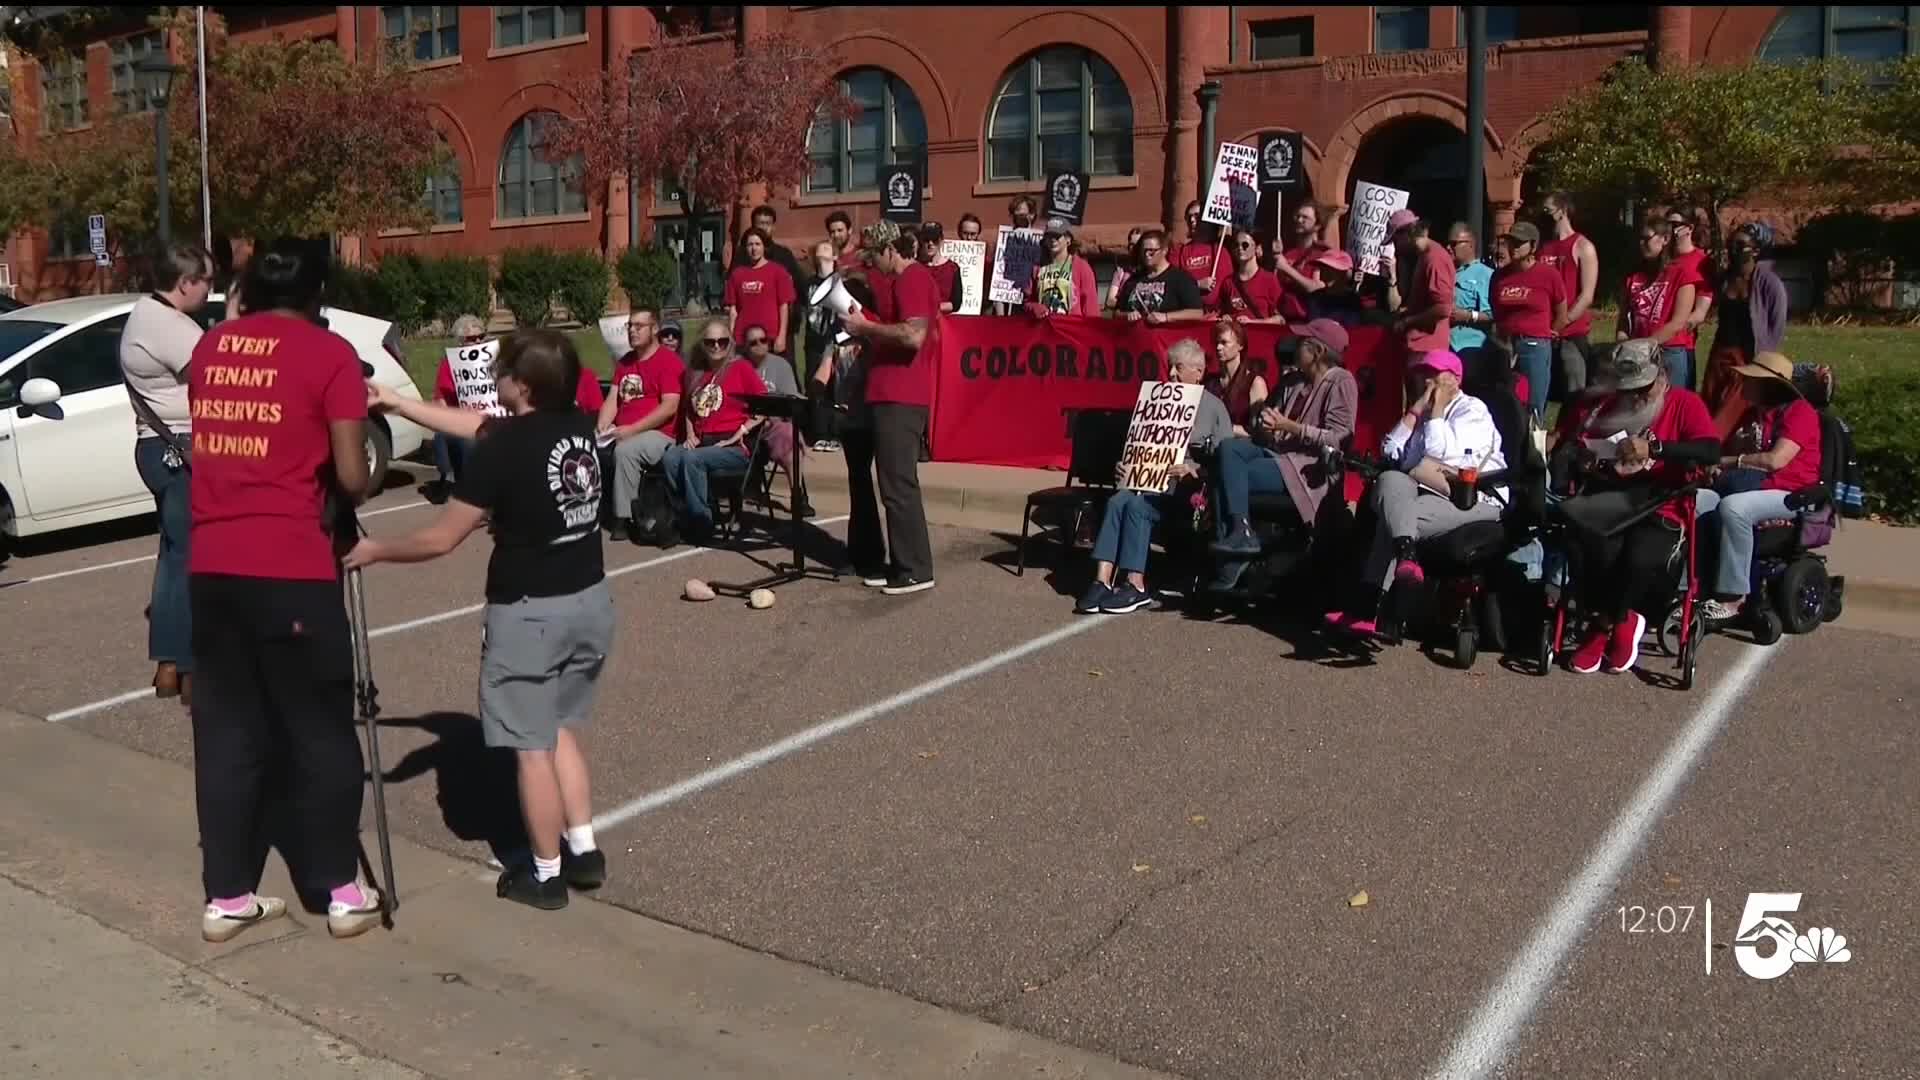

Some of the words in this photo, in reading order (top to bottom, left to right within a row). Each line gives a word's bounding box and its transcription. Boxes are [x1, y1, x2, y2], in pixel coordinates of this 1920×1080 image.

[1221, 155, 1257, 171] DESERV
[1223, 145, 1257, 159] TENAN
[1365, 187, 1397, 206] COS
[1354, 200, 1393, 226] HOUSIN
[1352, 220, 1385, 242] AUTHOR
[941, 241, 985, 256] TENANTS
[216, 334, 281, 356] EVERY
[459, 345, 493, 362] COS
[960, 343, 1160, 383] COLORADO
[204, 365, 279, 388] TENANT
[453, 366, 489, 383] HOUSI
[1151, 383, 1184, 401] COS
[193, 397, 282, 424] DESERVES
[1133, 400, 1195, 422] HOUSING
[208, 432, 270, 457] UNION
[1127, 424, 1193, 449] AUTHORITY
[1123, 444, 1178, 465] BARGAIN
